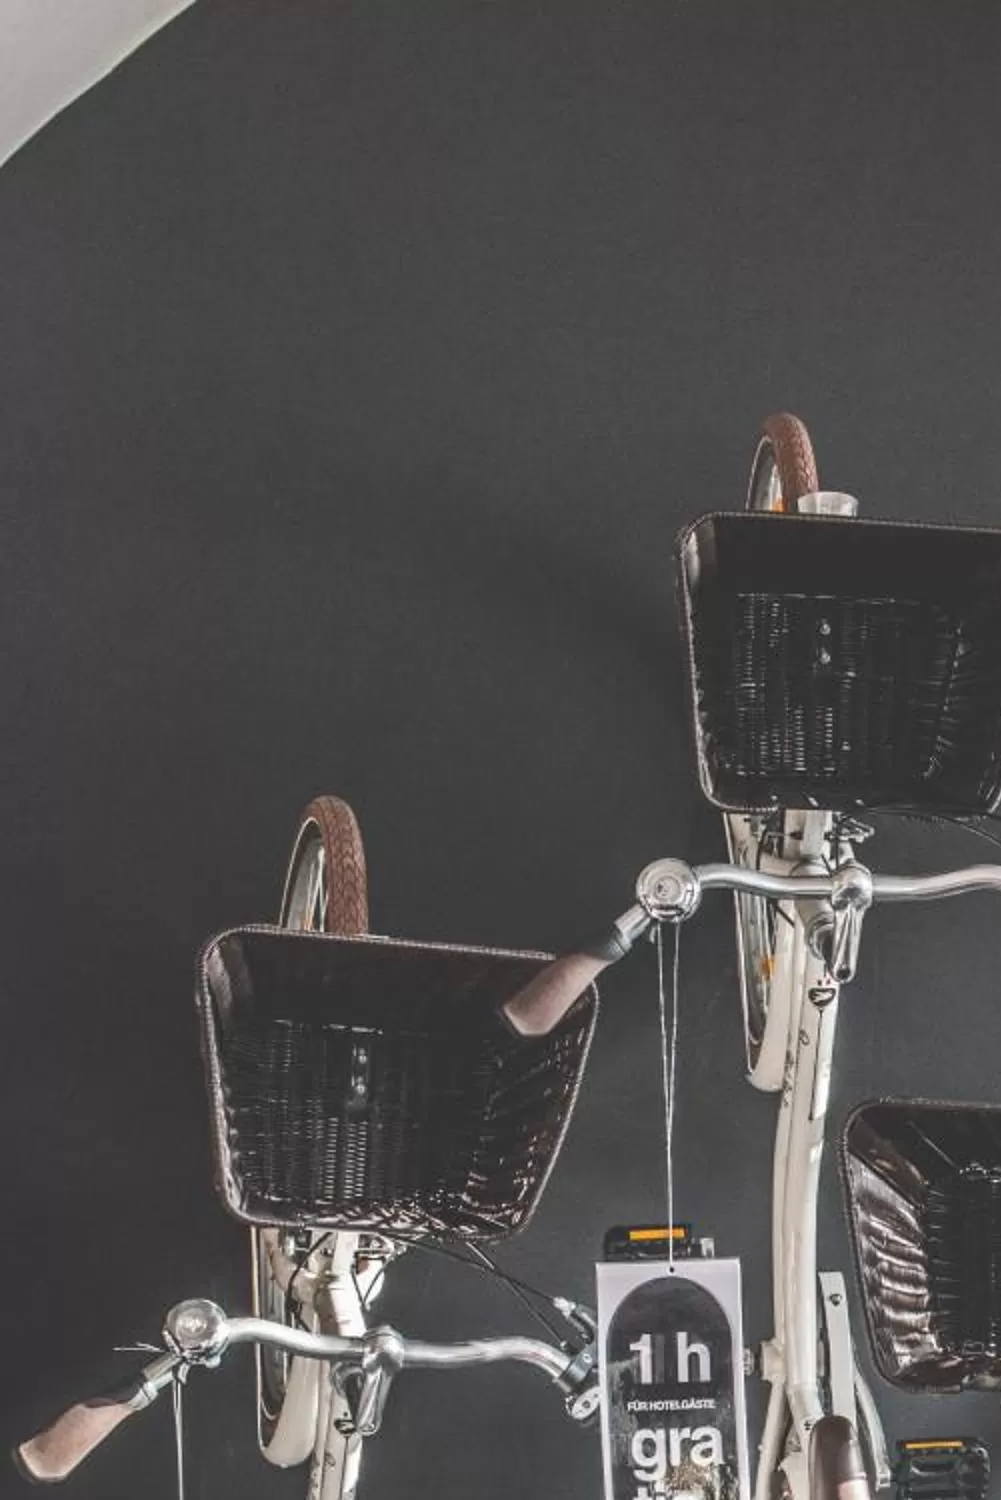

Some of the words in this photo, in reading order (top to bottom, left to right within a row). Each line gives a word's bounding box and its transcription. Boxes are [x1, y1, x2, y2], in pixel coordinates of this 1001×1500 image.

[630, 1333, 652, 1384] 1
[677, 1331, 711, 1383] h
[627, 1399, 649, 1411] FÜR
[631, 1425, 723, 1481] gra
